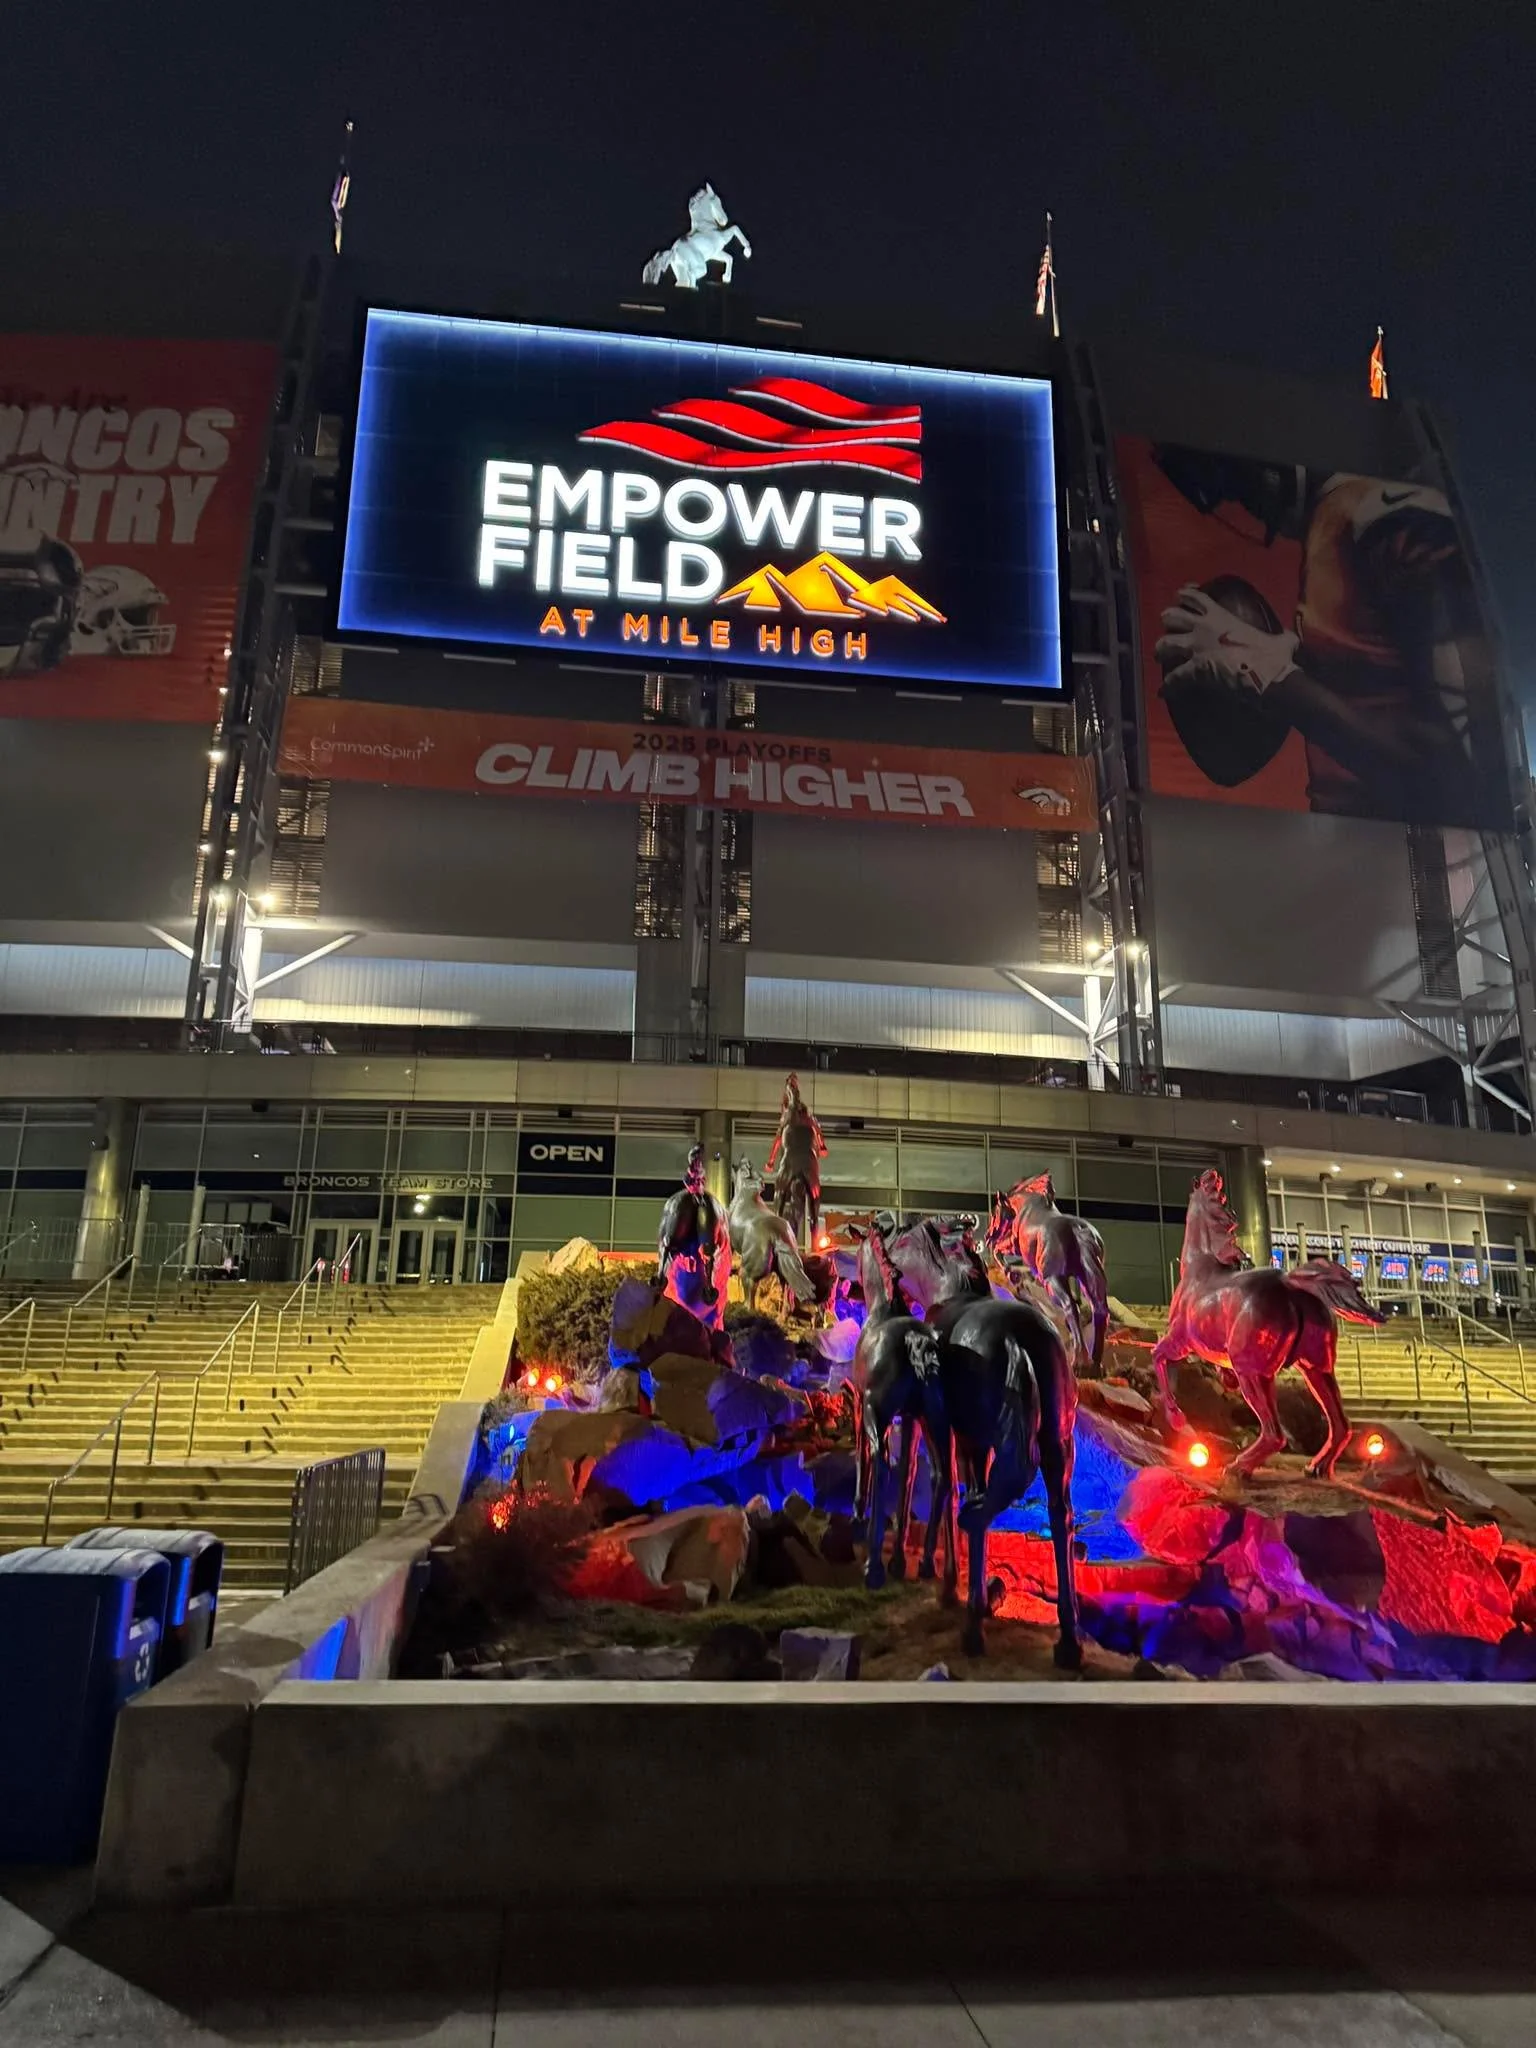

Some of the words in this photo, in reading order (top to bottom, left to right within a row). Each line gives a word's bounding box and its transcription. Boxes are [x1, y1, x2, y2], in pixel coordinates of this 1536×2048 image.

[483, 459, 922, 560] EMPOWER
[478, 523, 724, 602] FIELD
[539, 605, 594, 637] AT
[622, 613, 731, 648] MILE
[759, 623, 868, 659] HIGH
[633, 732, 696, 752] 2025
[705, 737, 831, 763] PLAYOFFS
[474, 742, 700, 796] CLIMB
[713, 757, 976, 817] HIGHER
[528, 1143, 605, 1163] OPEN
[283, 1175, 370, 1188] BRONCOS
[377, 1176, 428, 1189] TEAM
[436, 1176, 495, 1190] STORE
